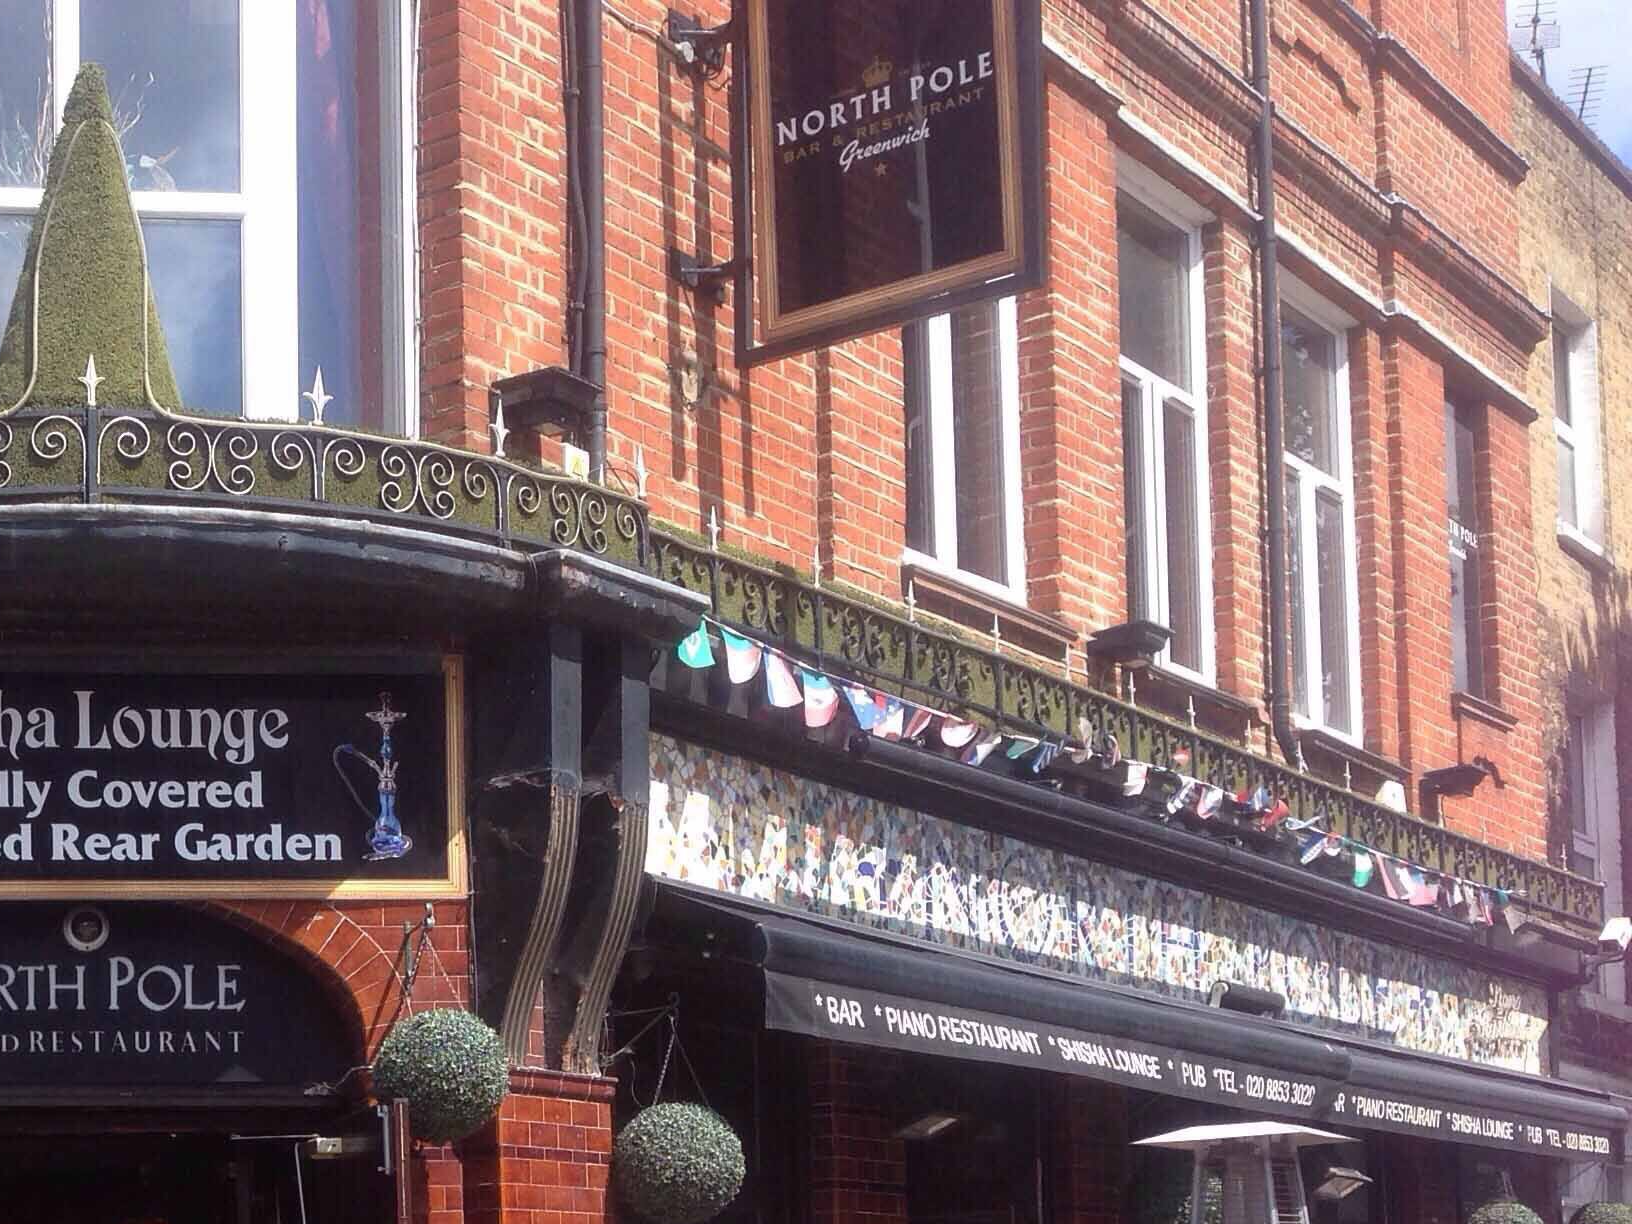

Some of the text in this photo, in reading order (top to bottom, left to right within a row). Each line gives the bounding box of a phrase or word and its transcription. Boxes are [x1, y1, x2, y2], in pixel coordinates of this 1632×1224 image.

[776, 50, 993, 146] NORTH POLE
[783, 143, 820, 164] BAR
[857, 87, 984, 137] RESTAURANT
[839, 119, 931, 173] Greenwich
[73, 690, 290, 764] Lounge
[66, 770, 264, 808] Covered
[51, 823, 160, 862] Rear
[174, 823, 343, 862] Garden
[107, 956, 247, 1012] POLE
[28, 1029, 245, 1053] RESTAURANT
[826, 996, 865, 1028] BAR
[885, 1006, 937, 1039] PIANO
[938, 1015, 1042, 1056] RESTAURANT
[1057, 1037, 1110, 1067] SHISHA
[1109, 1048, 1162, 1080] LOUNGE
[1181, 1061, 1207, 1088] PUB
[1246, 1075, 1264, 1098] 020
[1265, 1081, 1290, 1104] 8853
[1356, 1096, 1385, 1119] PIANO
[1385, 1100, 1442, 1130] RESTAURANT
[1451, 1113, 1482, 1135] SHISHA
[1481, 1118, 1514, 1141] LOUNGE
